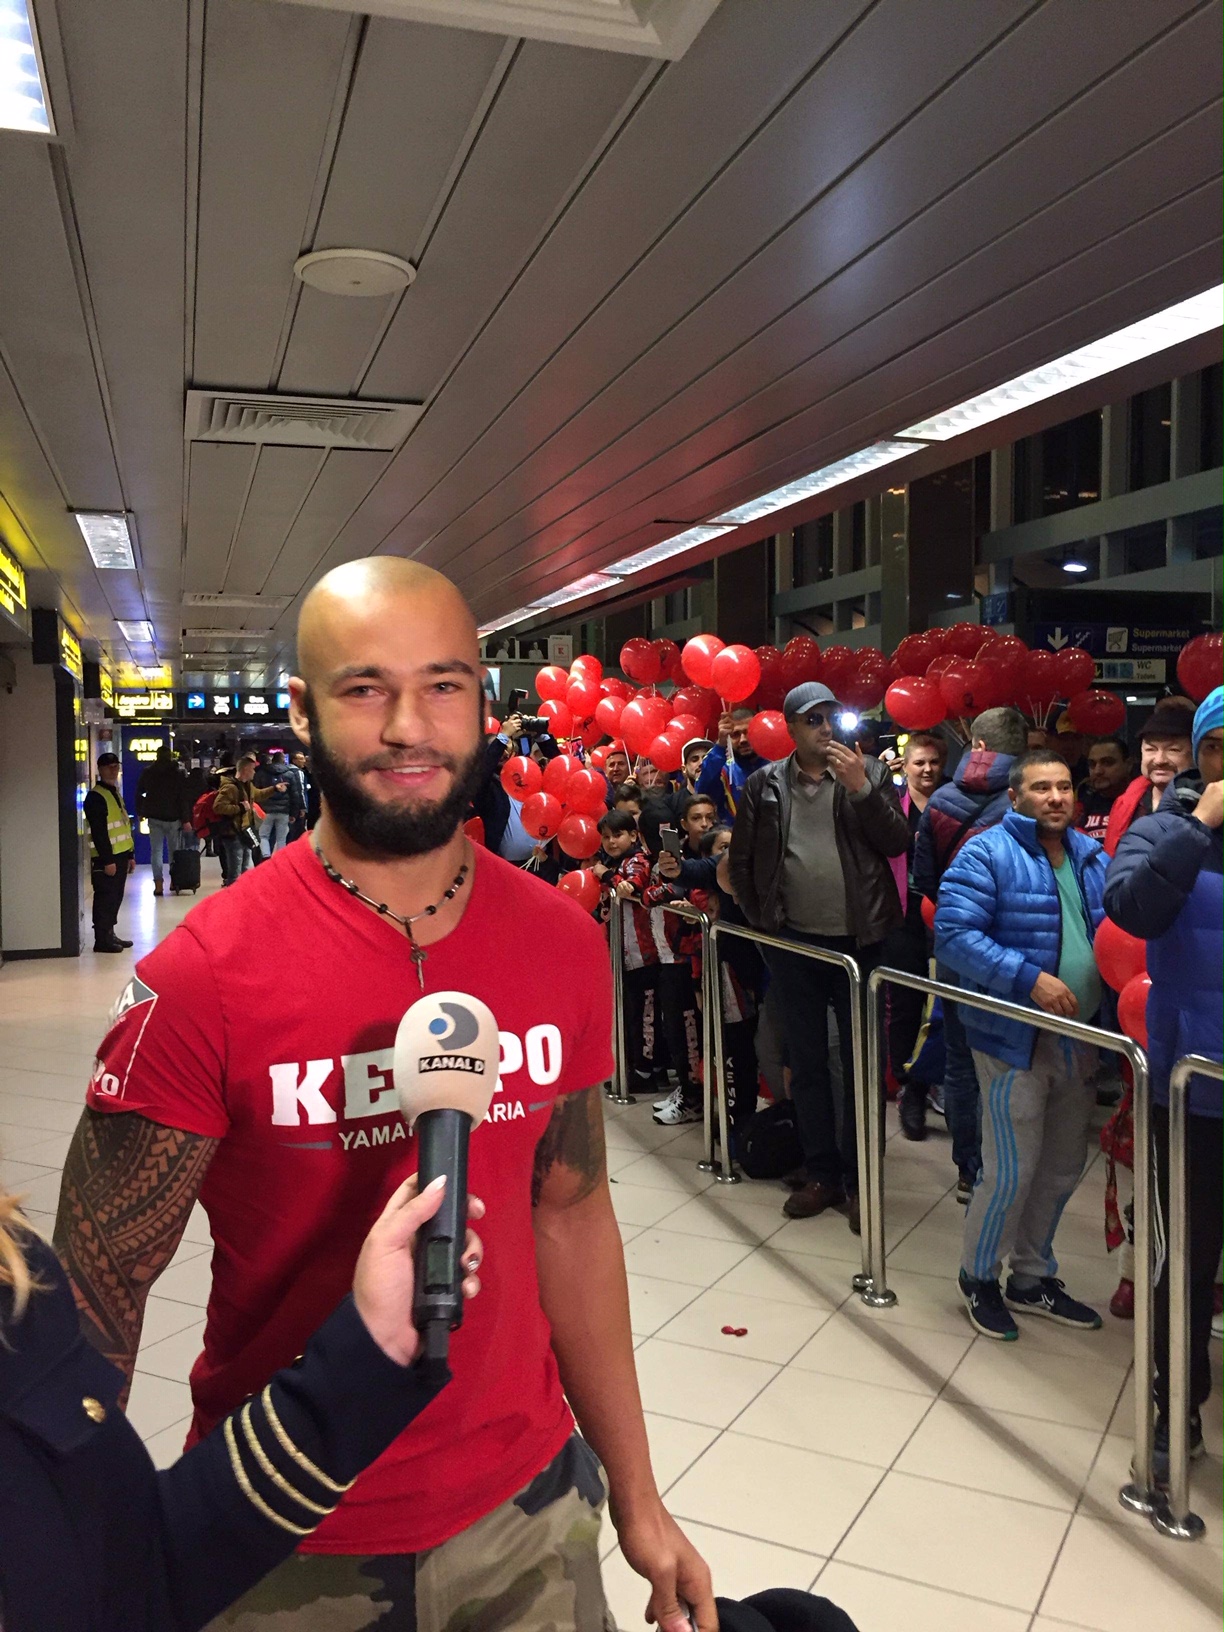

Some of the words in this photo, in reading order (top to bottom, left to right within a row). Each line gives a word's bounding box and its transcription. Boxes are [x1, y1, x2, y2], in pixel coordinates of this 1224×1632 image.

[1133, 628, 1189, 639] Supermarket
[1137, 661, 1151, 669] WC
[420, 1056, 473, 1071] KANAL
[474, 1060, 485, 1072] D
[269, 1023, 563, 1127] KEPO
